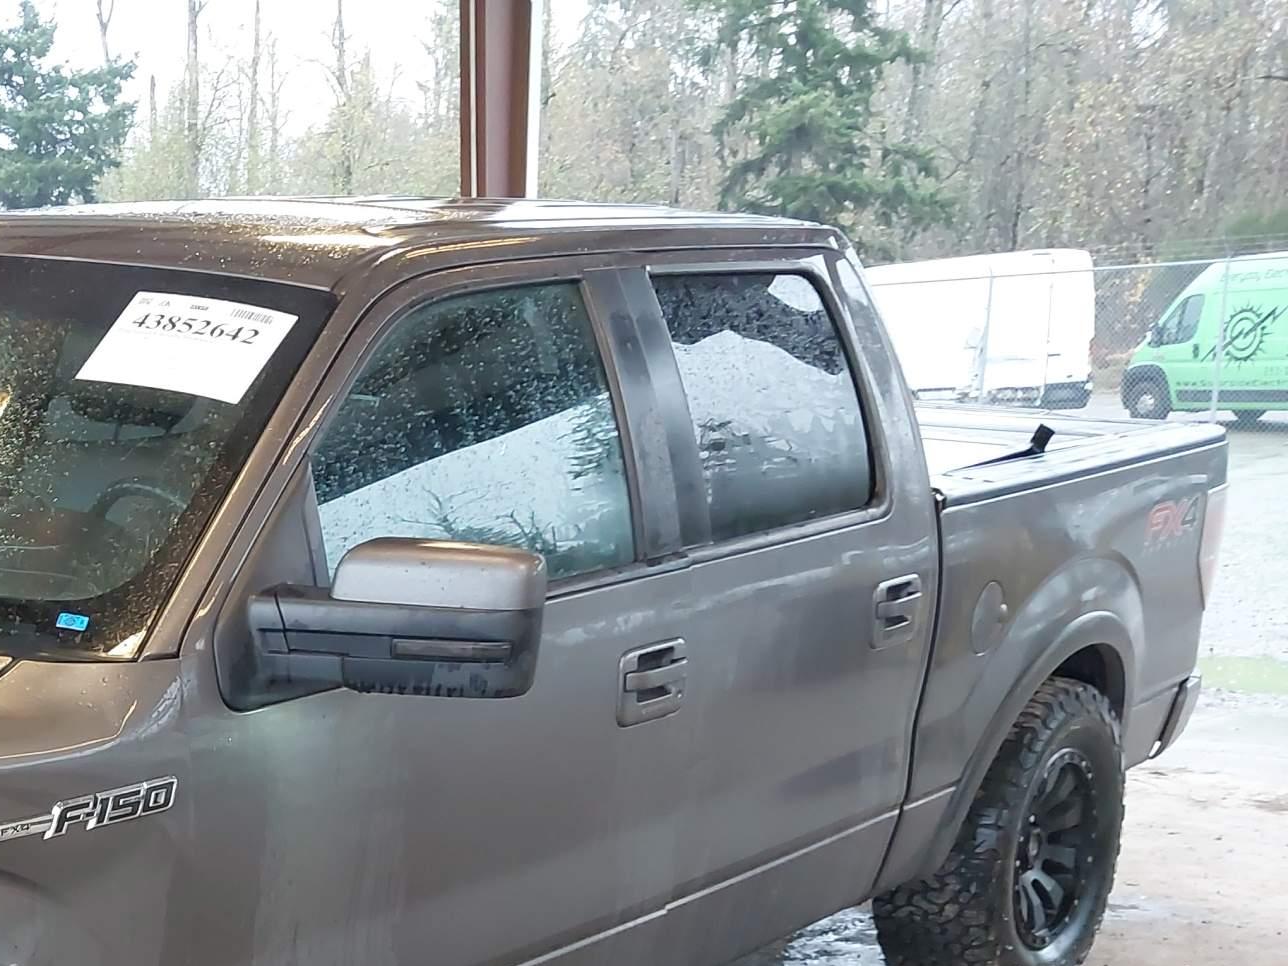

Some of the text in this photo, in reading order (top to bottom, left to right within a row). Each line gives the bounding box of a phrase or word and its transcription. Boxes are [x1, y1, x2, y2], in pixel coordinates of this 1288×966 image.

[131, 311, 261, 345] 43852642
[0, 776, 178, 841] FX4 F-150
